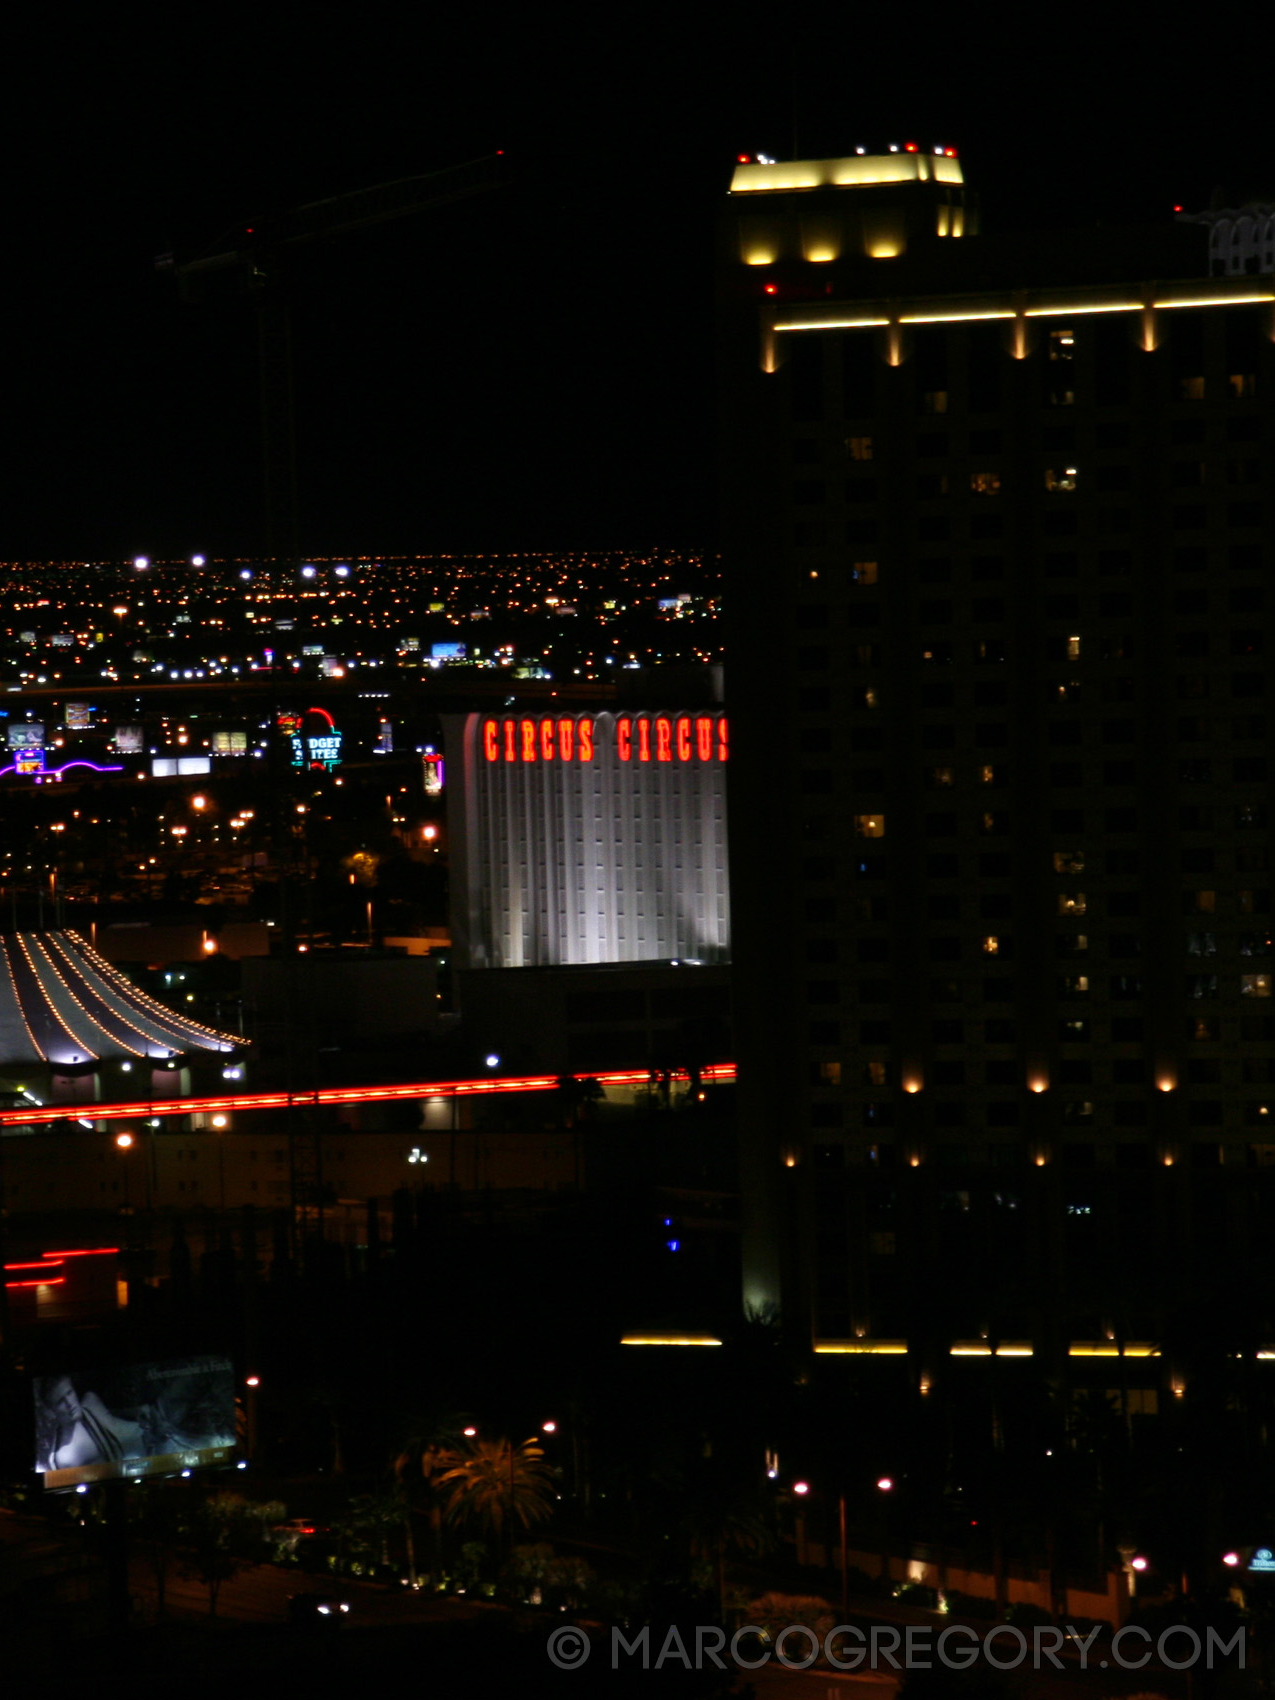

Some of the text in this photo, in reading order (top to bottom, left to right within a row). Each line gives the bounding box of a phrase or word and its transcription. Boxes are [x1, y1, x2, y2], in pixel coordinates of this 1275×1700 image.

[292, 737, 341, 750] BDGET
[484, 717, 728, 762] CIRCUS CIRCUS
[295, 748, 338, 760] SITES
